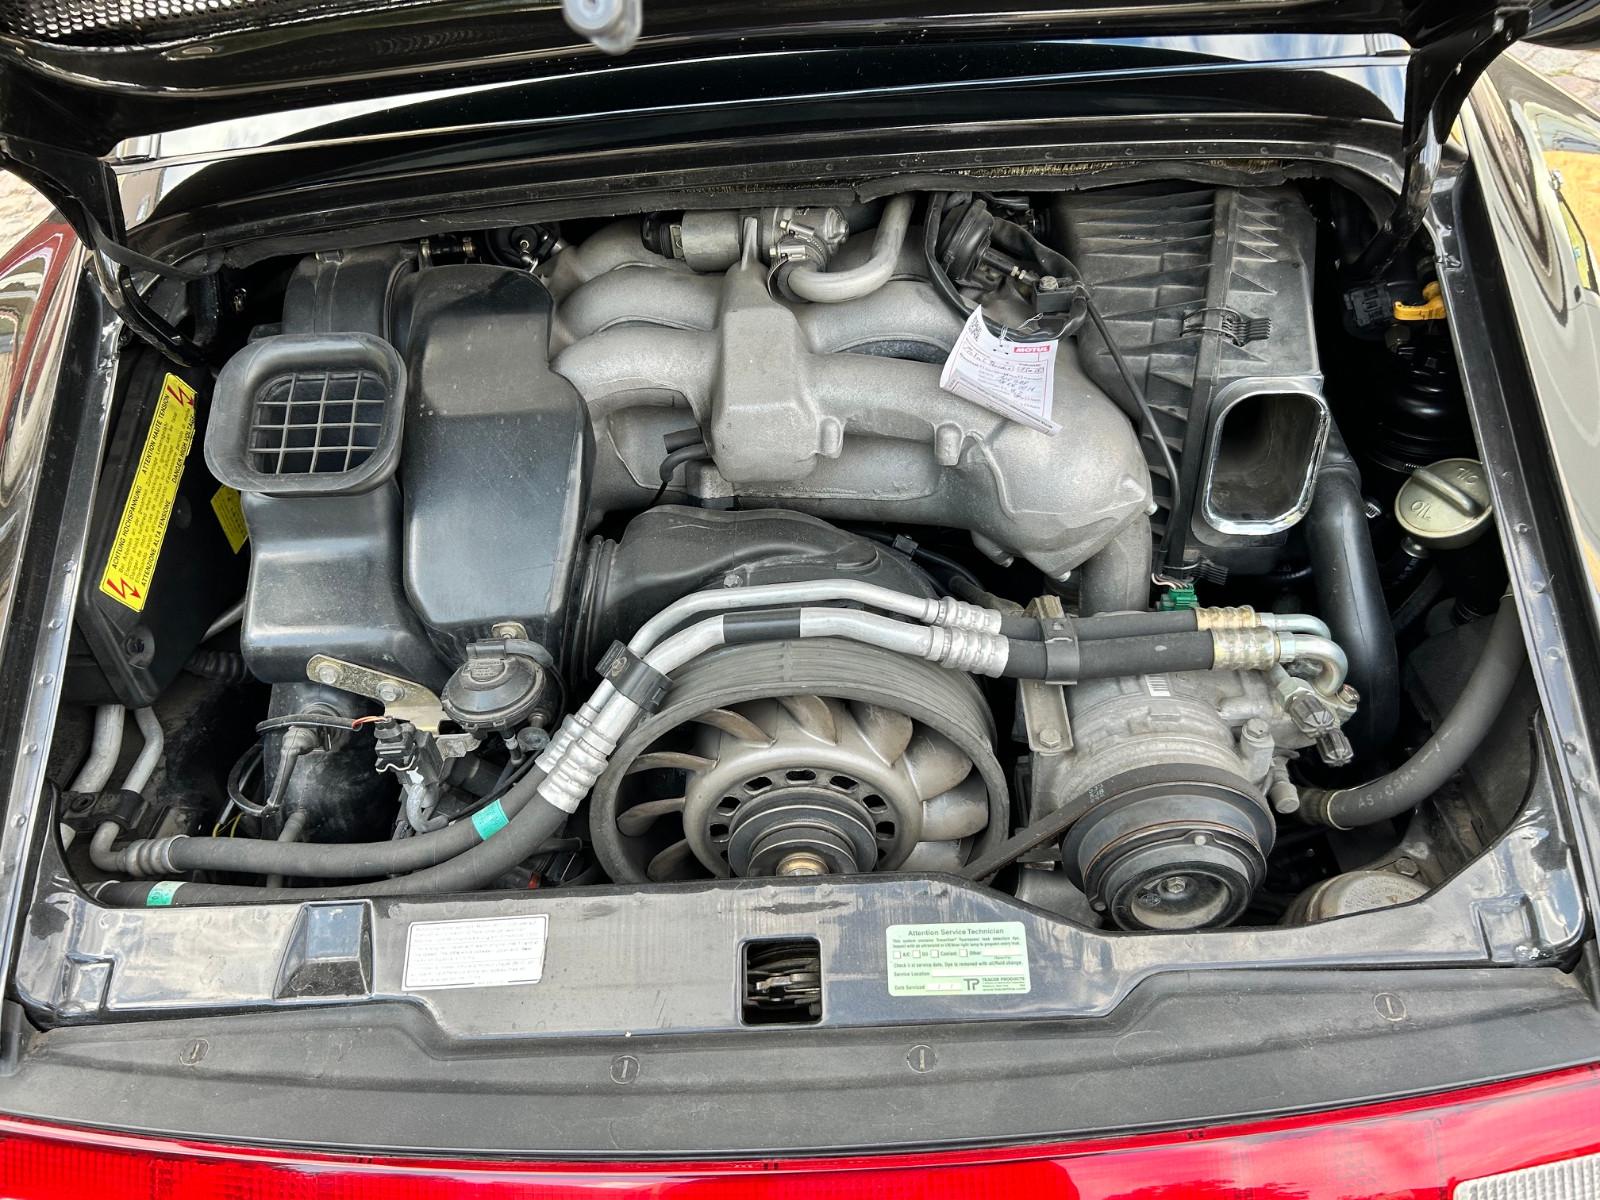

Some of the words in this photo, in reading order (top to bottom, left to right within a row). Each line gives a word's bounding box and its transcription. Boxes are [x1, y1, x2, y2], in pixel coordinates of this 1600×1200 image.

[142, 441, 155, 473] ATTENTION
[152, 420, 161, 439] HAUTE
[159, 395, 168, 418] TENSION
[172, 458, 181, 482] DANGER
[112, 537, 125, 569] ACHTUNG
[122, 484, 141, 536] HOCHSPANNUNG
[142, 548, 155, 586] ATTENZIONE
[158, 499, 169, 529] TENSIONE
